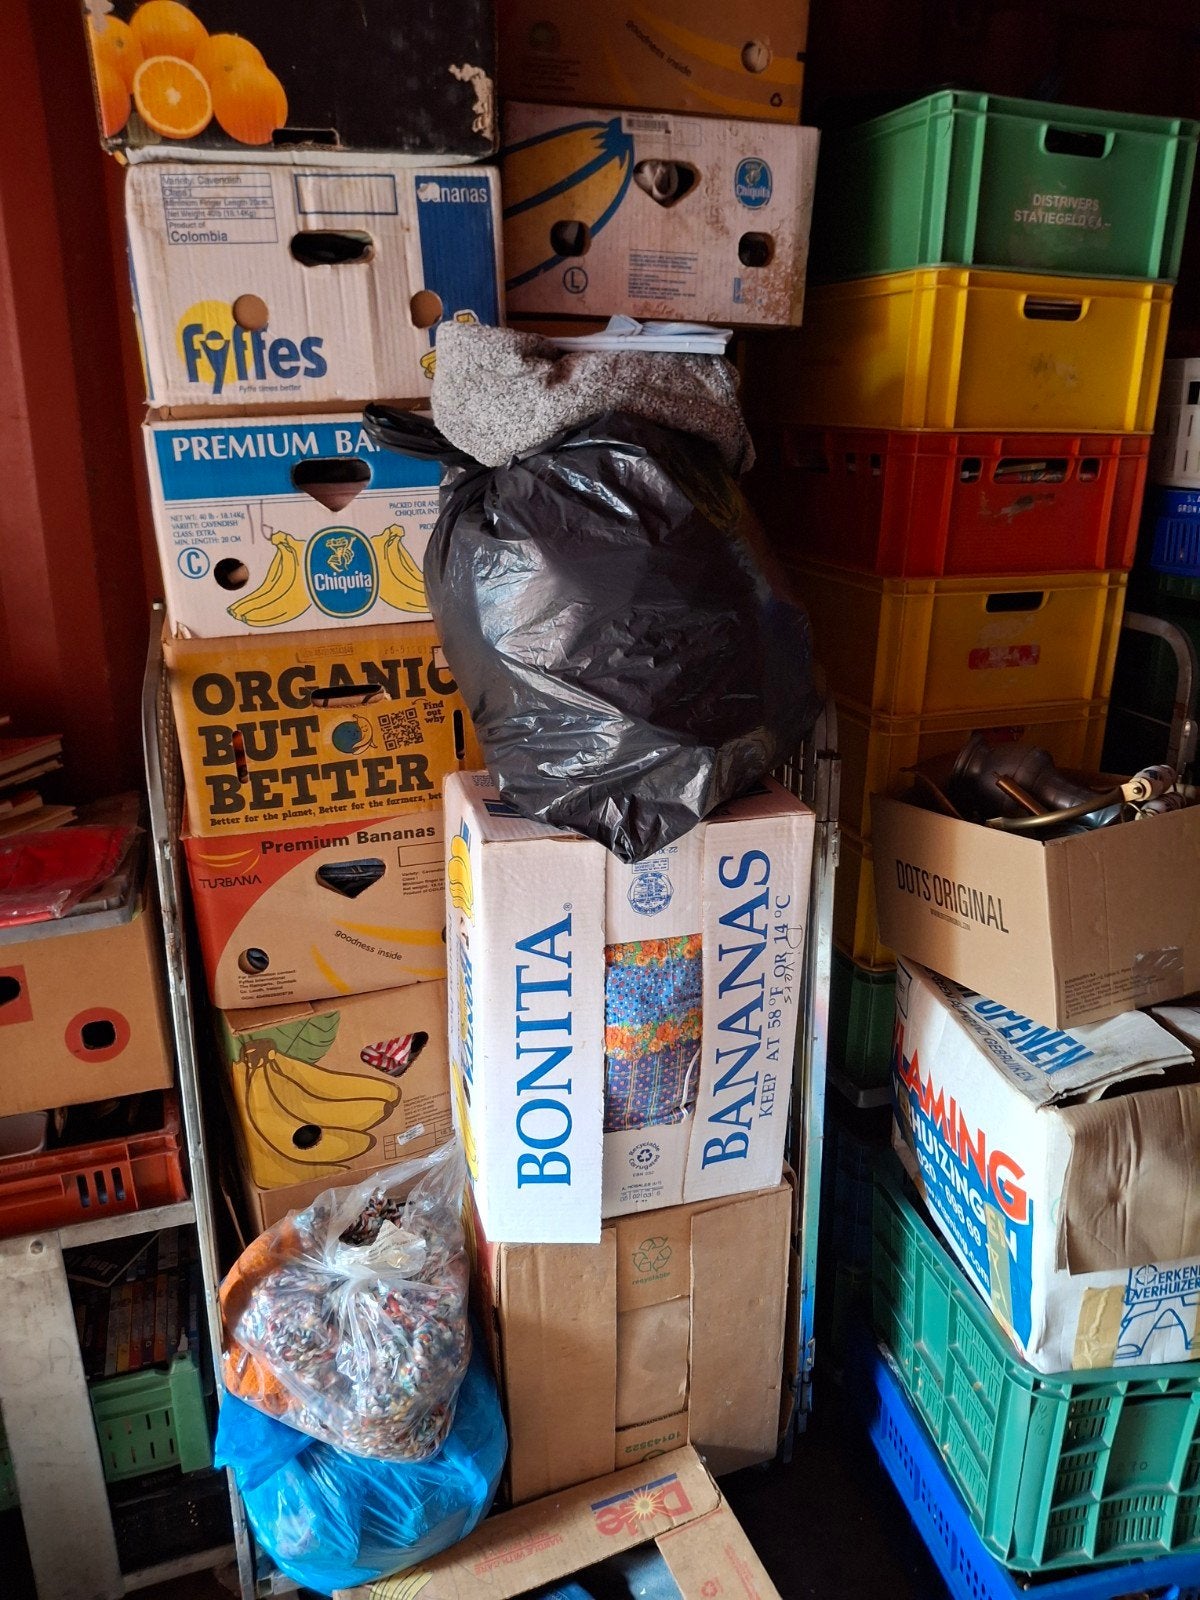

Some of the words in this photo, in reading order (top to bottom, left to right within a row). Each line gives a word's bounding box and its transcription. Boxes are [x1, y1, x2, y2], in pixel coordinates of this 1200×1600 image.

[417, 182, 488, 203] nanas
[737, 185, 771, 200] Chiquita
[1033, 194, 1100, 211] DISTRIVERS
[169, 221, 196, 229] Product
[1014, 210, 1086, 226] STATIEGELD
[171, 230, 228, 242] Colombia
[183, 321, 327, 394] fyffes
[280, 384, 302, 392] better
[171, 431, 320, 461] PREMIUM
[196, 529, 216, 538] EXTRA
[201, 520, 239, 529] CAVENDISH
[314, 571, 373, 594] Chiquita
[193, 657, 460, 716] ORGANIC
[422, 701, 444, 711] Find
[426, 709, 442, 717] out
[424, 715, 446, 724] why
[198, 715, 321, 767] BUT
[205, 754, 435, 816] BETTER
[210, 817, 241, 827] Better
[244, 813, 259, 823] for
[263, 811, 279, 821] the
[282, 808, 317, 821] planet,
[319, 803, 348, 815] Better
[351, 801, 365, 811] for
[368, 799, 384, 809] the
[261, 834, 350, 854] Premium
[356, 827, 436, 845] Bananas
[198, 874, 262, 889] TURBANA
[933, 874, 1010, 934] ORIGINAL
[334, 930, 375, 953] goodness
[377, 948, 403, 961] inside
[774, 950, 787, 979] OR
[701, 849, 771, 1170] BANANAS
[515, 912, 573, 1189] BONITA
[766, 1037, 780, 1062] AT
[983, 1035, 1036, 1082] GEBRUIKEN
[759, 1072, 777, 1119] KEEP
[628, 1141, 661, 1156] Recyclable
[628, 1154, 661, 1170] Corrugated
[917, 1147, 937, 1183] 020
[632, 1272, 671, 1286] recyclable
